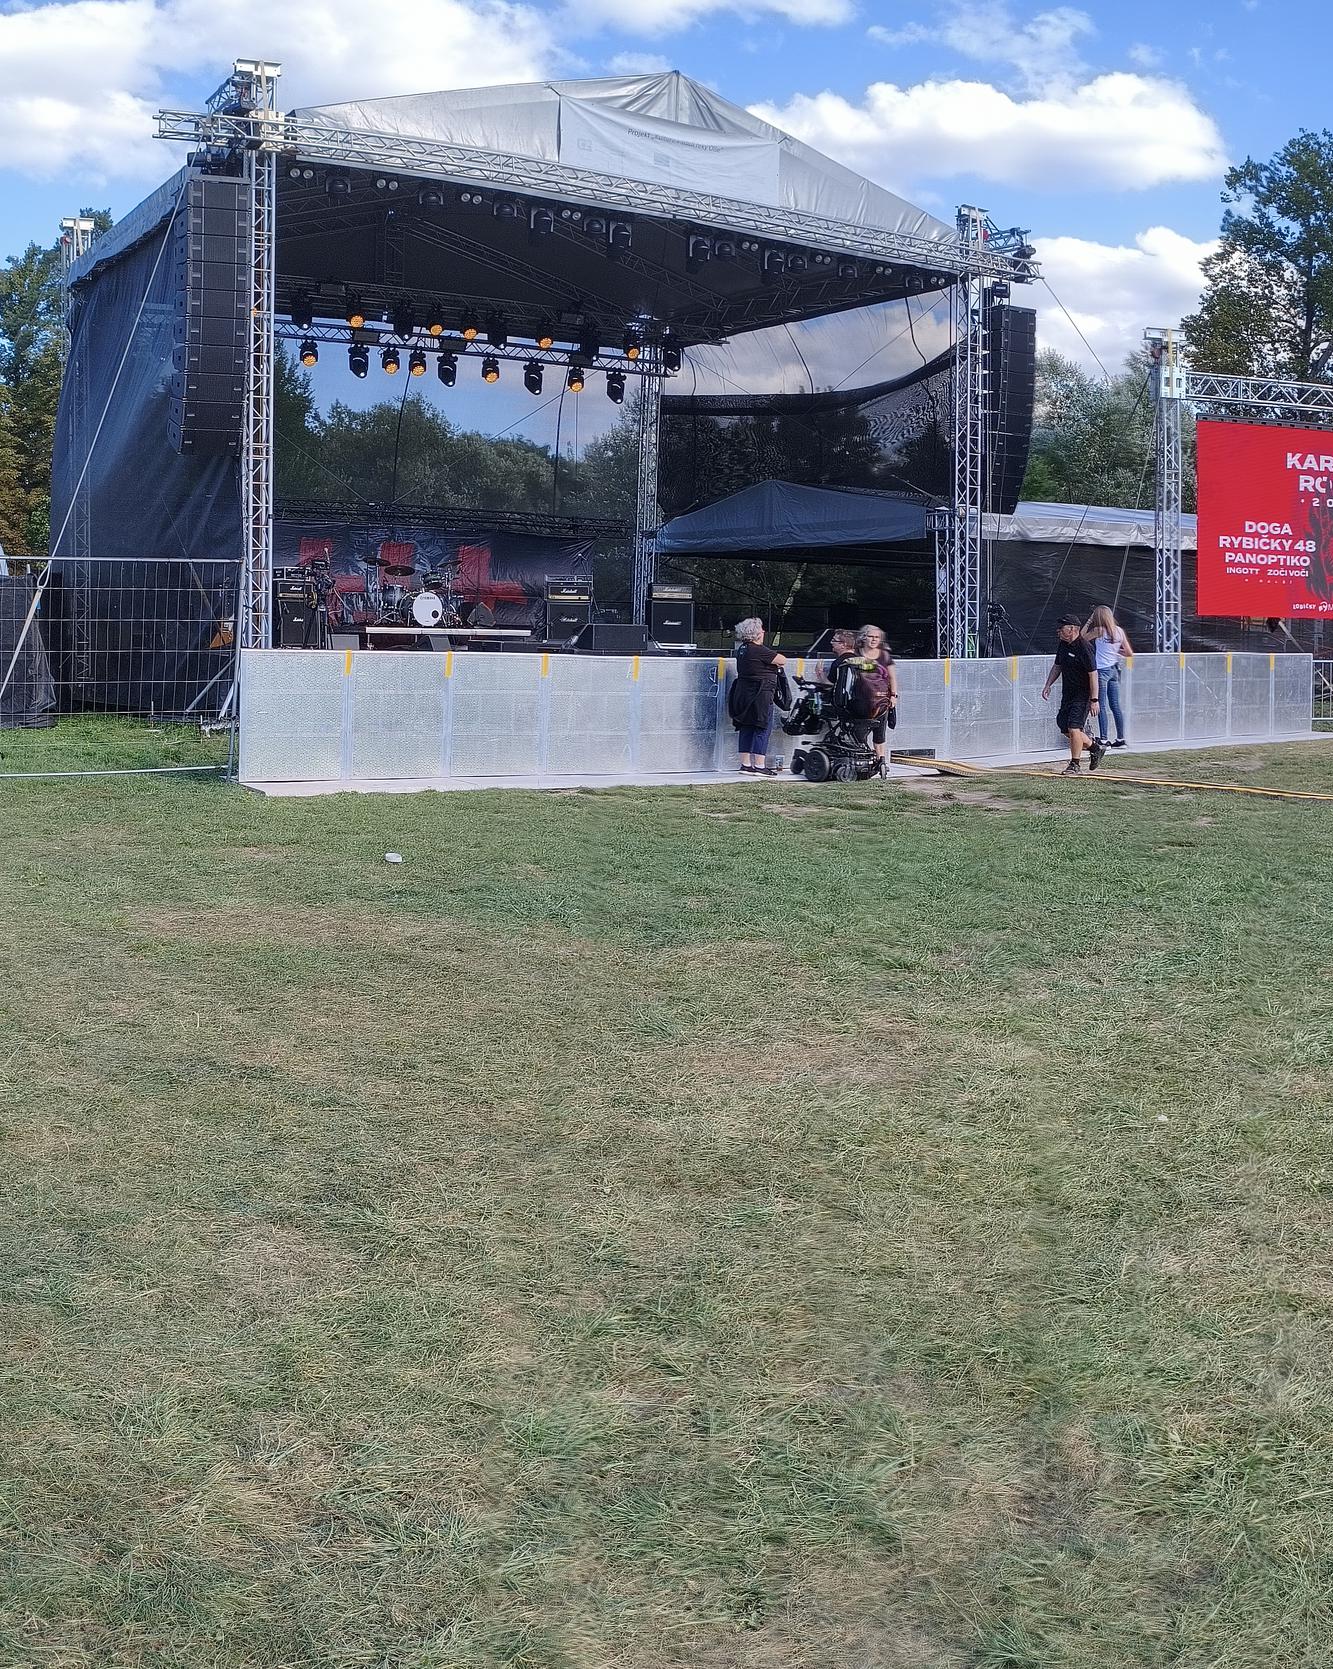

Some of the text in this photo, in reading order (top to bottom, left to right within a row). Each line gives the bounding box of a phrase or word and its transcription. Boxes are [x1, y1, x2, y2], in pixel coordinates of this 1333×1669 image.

[1244, 521, 1293, 535] DOGA
[1218, 535, 1317, 552] RYBIČKY 48
[1225, 552, 1311, 567] PANOPTIKO
[1226, 567, 1309, 577] INGOTT ZOČI VOČI
